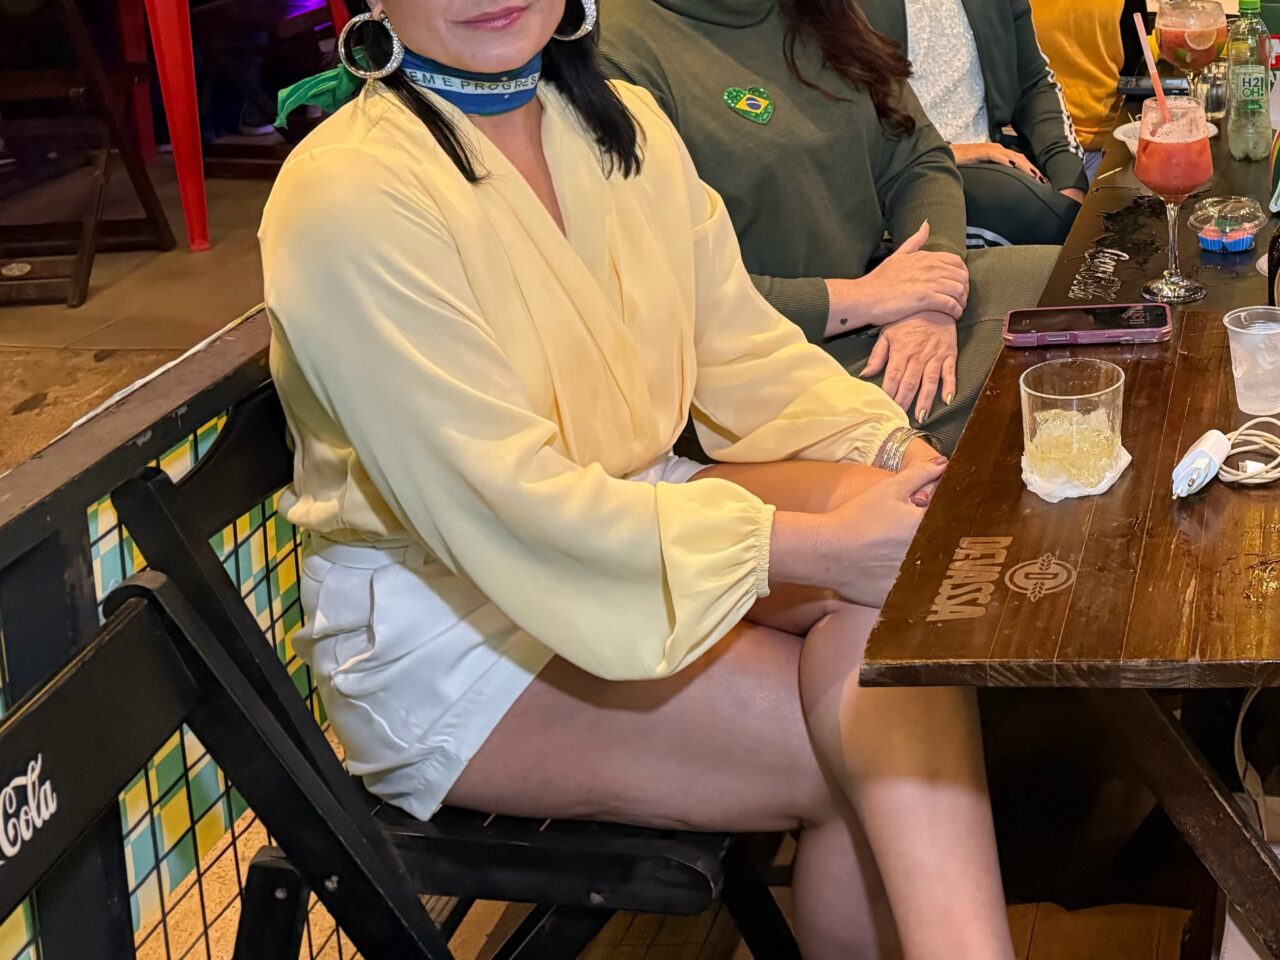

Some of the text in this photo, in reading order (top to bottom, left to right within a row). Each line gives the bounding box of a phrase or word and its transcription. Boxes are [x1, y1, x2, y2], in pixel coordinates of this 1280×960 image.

[442, 76, 454, 88] E
[460, 73, 540, 91] PROGRES
[1242, 77, 1261, 88] H2
[925, 536, 1014, 622] DEVASSA
